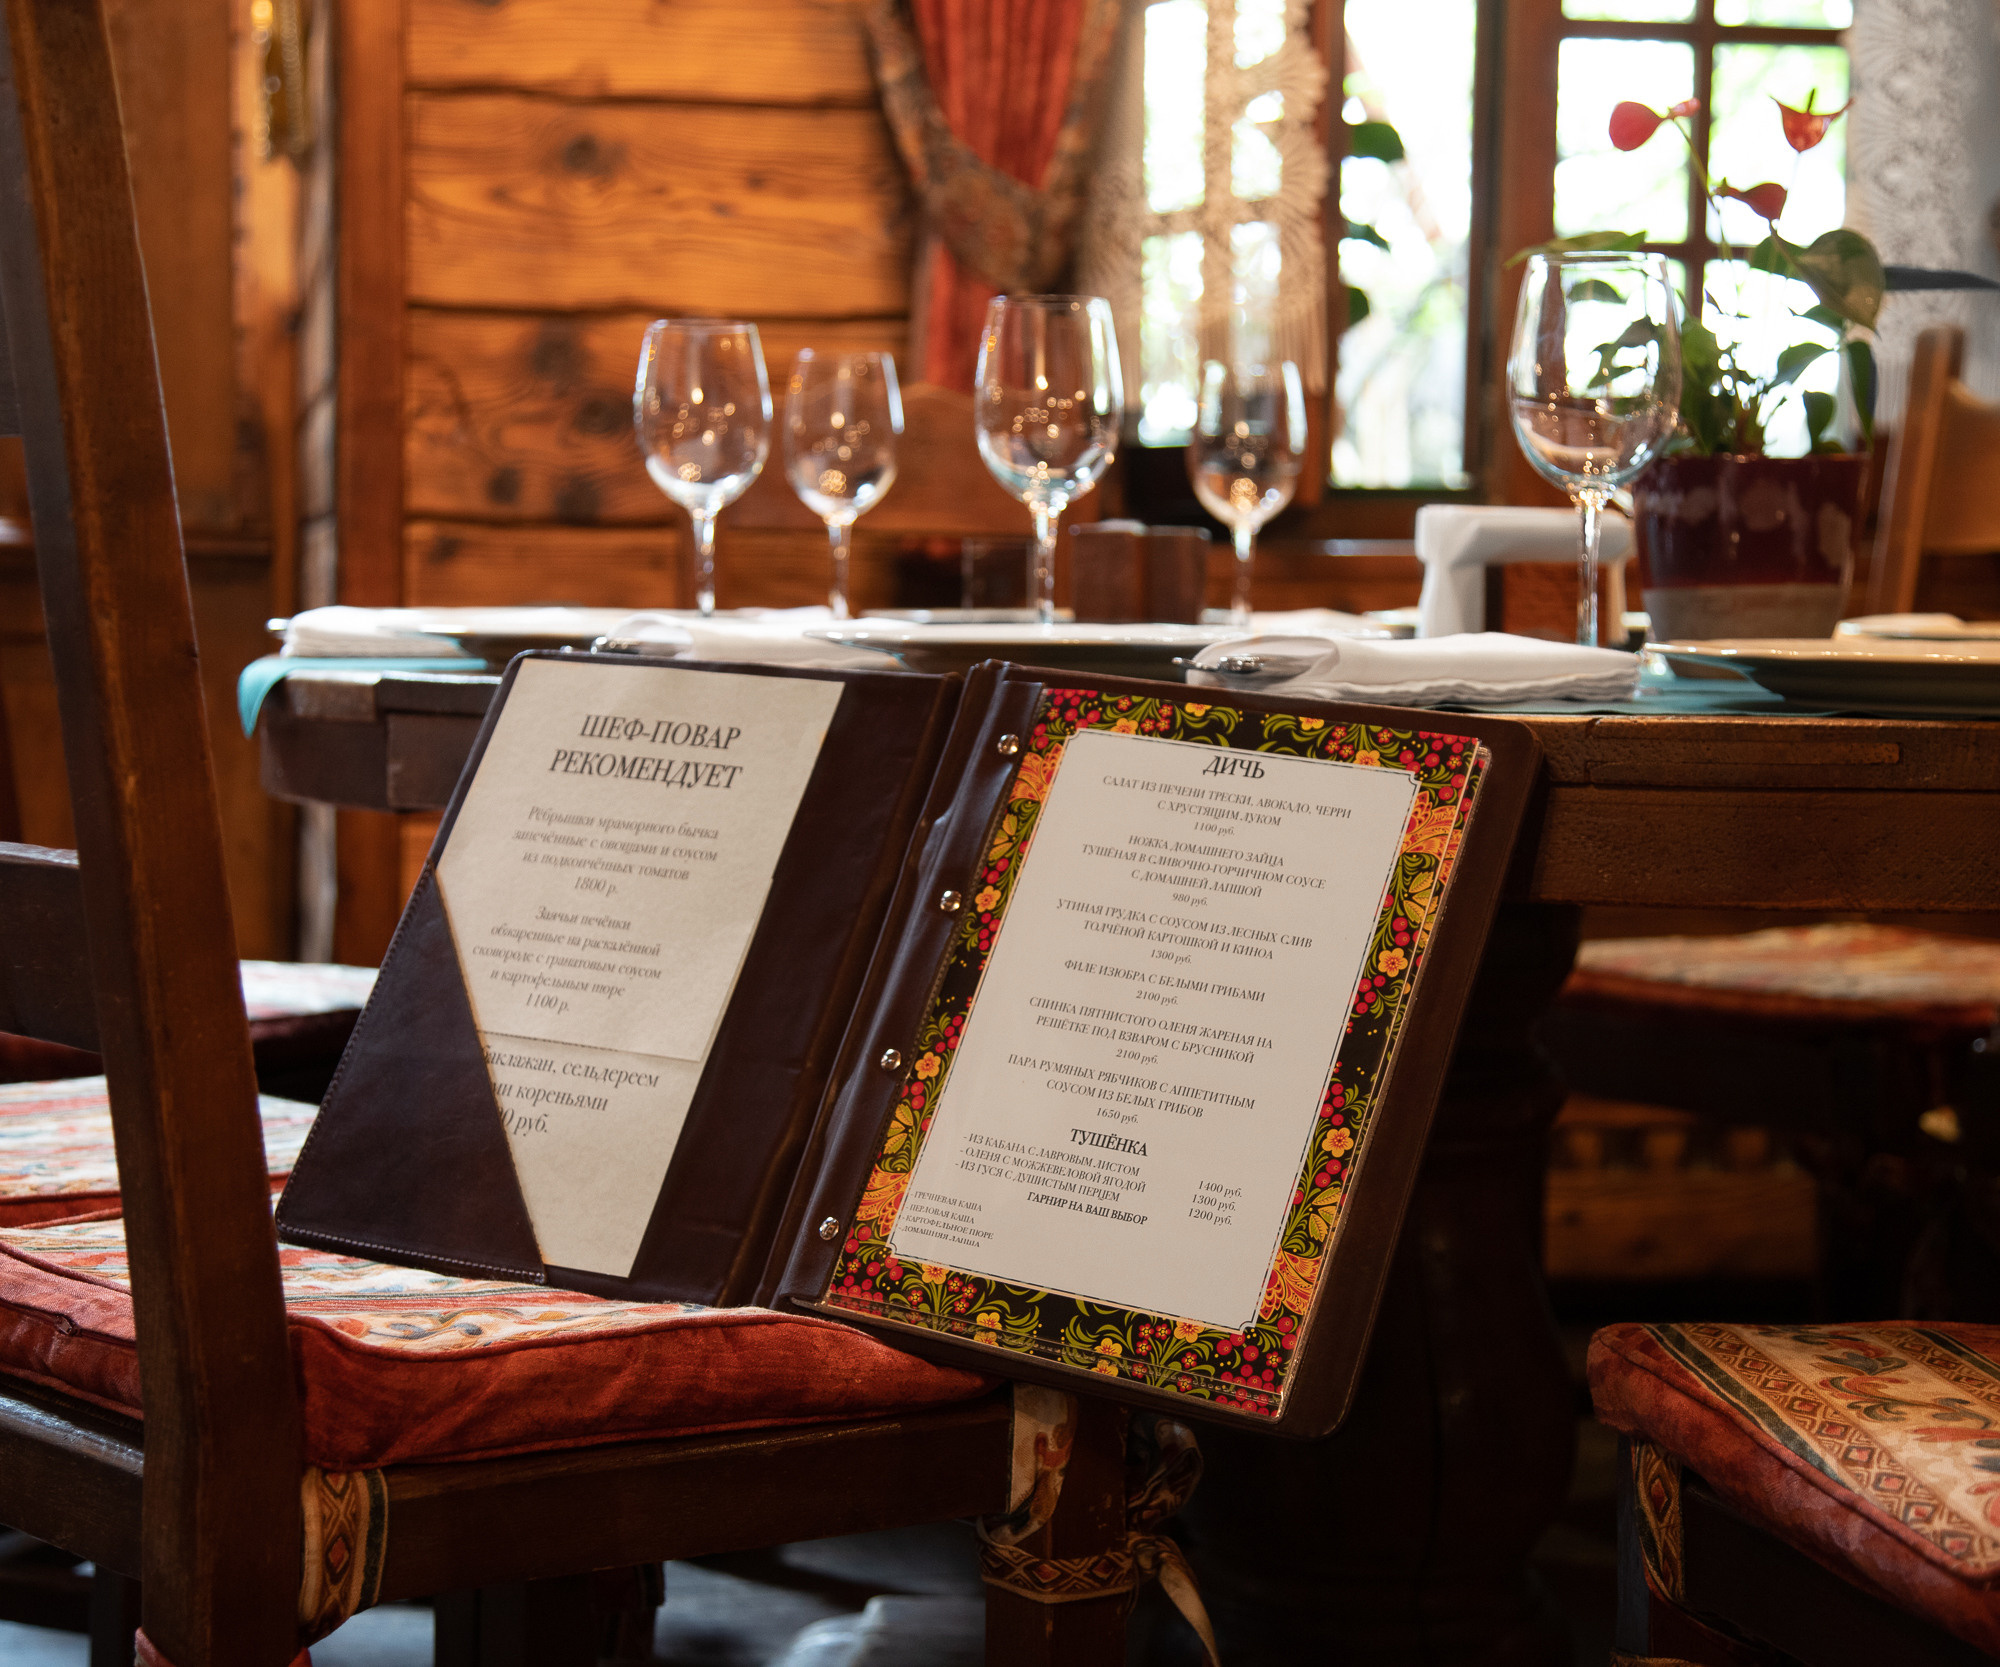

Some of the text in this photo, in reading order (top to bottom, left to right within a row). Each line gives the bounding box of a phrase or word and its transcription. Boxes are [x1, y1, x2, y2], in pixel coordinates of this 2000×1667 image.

[579, 714, 742, 750] ШЕФ-ПОВАР
[549, 749, 744, 790] РЕКОМЕНДУЕТ
[1202, 755, 1266, 780] ДИЧЬ
[1102, 775, 1352, 820] САЛАТ ИЗ ПЕЧЕНИ ТРЕСКИ, АВОКАДО, ЧЕРРИ
[527, 805, 720, 841] Рёбрышки мраморного бычка
[1156, 800, 1282, 827] С ХРУСТЯЩИМ ЛУКОМ
[1193, 821, 1235, 837] 1100 руб.
[511, 829, 588, 848] запечённые
[599, 839, 659, 856] овощами
[671, 847, 719, 863] соусом
[1127, 834, 1284, 868] НОЖКА ДОМАШНЕГО ЗАЙЦА
[521, 851, 691, 881] из подкопчённых томатов
[1082, 843, 1327, 890] ТУШЁНАЯ В СЛИВОЧНО-ГОРЧИЧНОМ СОУСЕ
[573, 875, 608, 893] 1800
[1130, 869, 1263, 898] С ДОМАШНЕЙ ЛАПШОЙ
[1171, 892, 1208, 908] 980 руб.
[534, 905, 632, 931] Заячьи печёнки
[1056, 897, 1313, 949] УТИНАЯ ГРУДКА С СОУСОМ ИЗ ЛЕСНЫХ СЛИВ
[490, 922, 662, 957] обжаренные на раскалённой
[1083, 919, 1273, 960] ТОЛЧЁНОЙ КАРТОШКОЙ И КИНОА
[471, 945, 535, 964] сковороде
[544, 954, 617, 974] гранатовым
[617, 964, 663, 981] соусом
[1150, 948, 1192, 966] 1300 руб.
[500, 970, 590, 992] картофельным
[590, 983, 626, 1000] пюре
[1063, 959, 1266, 1003] ФИЛЕ ИЗЮБРА С БЕЛЫМИ ГРИБАМИ
[525, 992, 559, 1009] 1100
[1135, 989, 1179, 1007] 2100 руб.
[1028, 996, 1273, 1050] СПИНКА ПЯТНИСТОГО ОЛЕНЯ ЖАРЕНАЯ НА
[1035, 1014, 1255, 1064] РЕШЁТКЕ ПОД ВЗВАРОМ С БРУСНИКОЙ
[1115, 1048, 1159, 1066] 2100 руб.
[561, 1062, 660, 1090] сельдереем
[1007, 1053, 1256, 1110] ПАРА РУМЯНЫХ РЯБЧИКОВ С АППЕТИТНЫМ
[515, 1085, 609, 1112] кореньями
[1046, 1079, 1204, 1118] СОУСОМ ИЗ БЕЛЫХ ГРИБОВ
[1096, 1107, 1139, 1125] 1650 руб.
[968, 1132, 985, 1145] ИЗ
[984, 1136, 1026, 1155] КАБАНА
[1027, 1146, 1037, 1156] С
[1035, 1147, 1094, 1168] ЛАВРОВЫМ
[1092, 1159, 1141, 1177] ЛИСТОМ
[1070, 1127, 1148, 1157] ТУШЁНКА
[959, 1159, 977, 1172] ИЗ
[975, 1163, 1005, 1178] ГУСЯ
[1003, 1169, 1014, 1180] С
[1012, 1171, 1078, 1194] ДУШИСТЫМ
[1077, 1184, 1121, 1203] ПЕРЦЕМ
[964, 1146, 1002, 1163] ОЛЕНЯ
[1001, 1155, 1012, 1165] С
[1013, 1156, 1103, 1184] МОЖЖЕВЕЛОВОЙ
[1101, 1175, 1147, 1193] ЯГОДОЙ
[913, 1190, 958, 1207] ГРЕЧНЕВАЯ
[957, 1199, 983, 1213] КАША
[1191, 1193, 1236, 1213] 1300 руб.
[1198, 1180, 1243, 1199] 1400 руб.
[909, 1203, 951, 1219] ПЕРЛОВАЯ
[949, 1211, 975, 1225] КАША
[1026, 1191, 1149, 1226] ГАРНИР НА ВАШ ВЫБОР
[1188, 1207, 1233, 1227] 1200 руб.
[901, 1225, 950, 1241] ДОМАШНЯЯ
[948, 1235, 981, 1248] ЛАПША
[905, 1214, 970, 1235] КАРТОФЕЛЬНОЕ
[968, 1227, 995, 1240] ПЮРЕ
